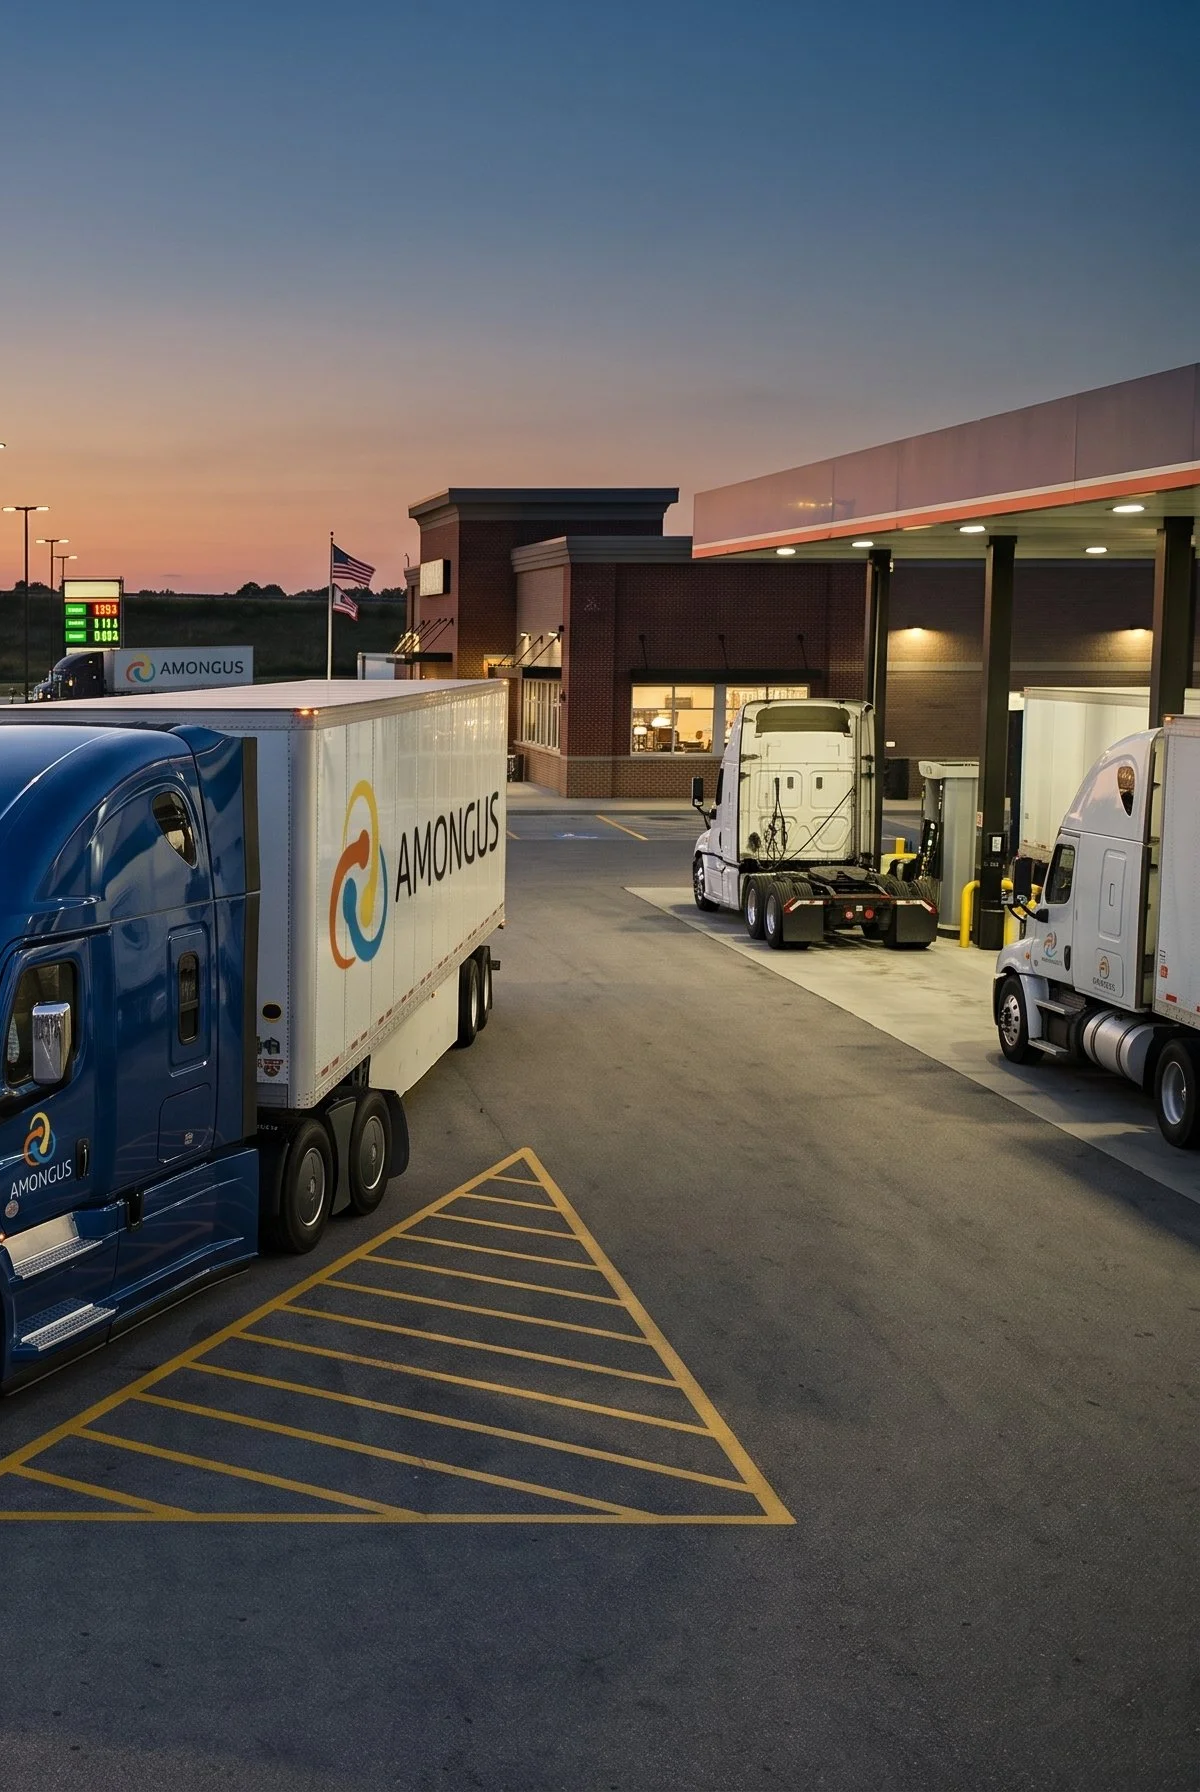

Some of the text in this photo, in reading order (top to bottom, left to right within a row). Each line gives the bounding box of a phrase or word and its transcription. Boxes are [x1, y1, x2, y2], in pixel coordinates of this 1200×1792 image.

[160, 660, 244, 676] AMONGUS
[395, 791, 500, 903] AMONGUS
[9, 1159, 73, 1200] AMONGUS
